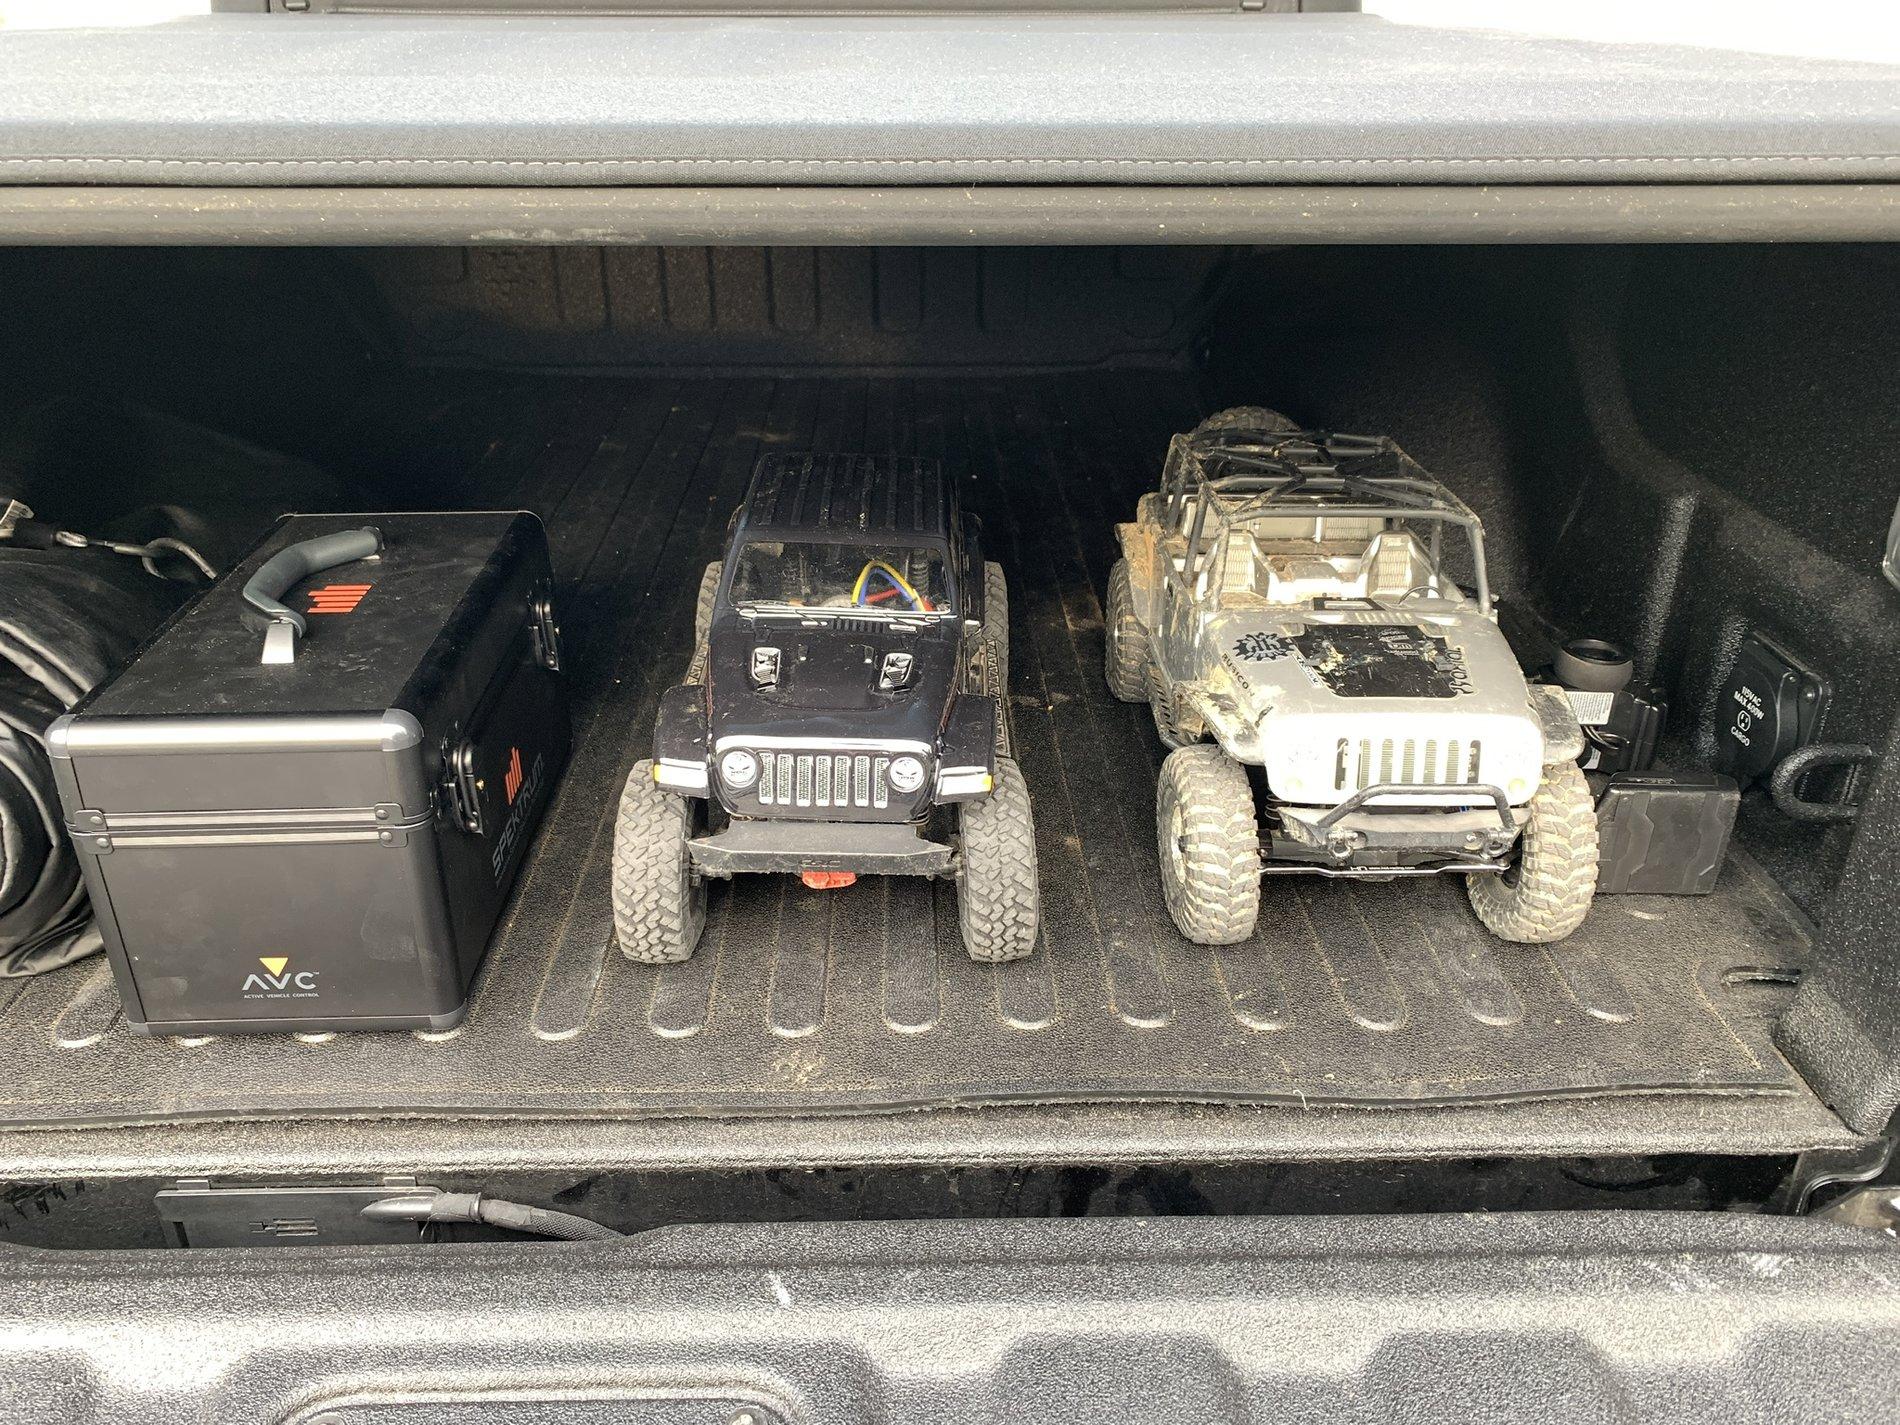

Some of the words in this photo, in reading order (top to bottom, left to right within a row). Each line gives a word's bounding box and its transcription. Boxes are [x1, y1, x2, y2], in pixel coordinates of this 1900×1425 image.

[1733, 690, 1748, 707] MAX
[1731, 726, 1750, 747] CARGO
[492, 752, 544, 877] SPEKTRUM
